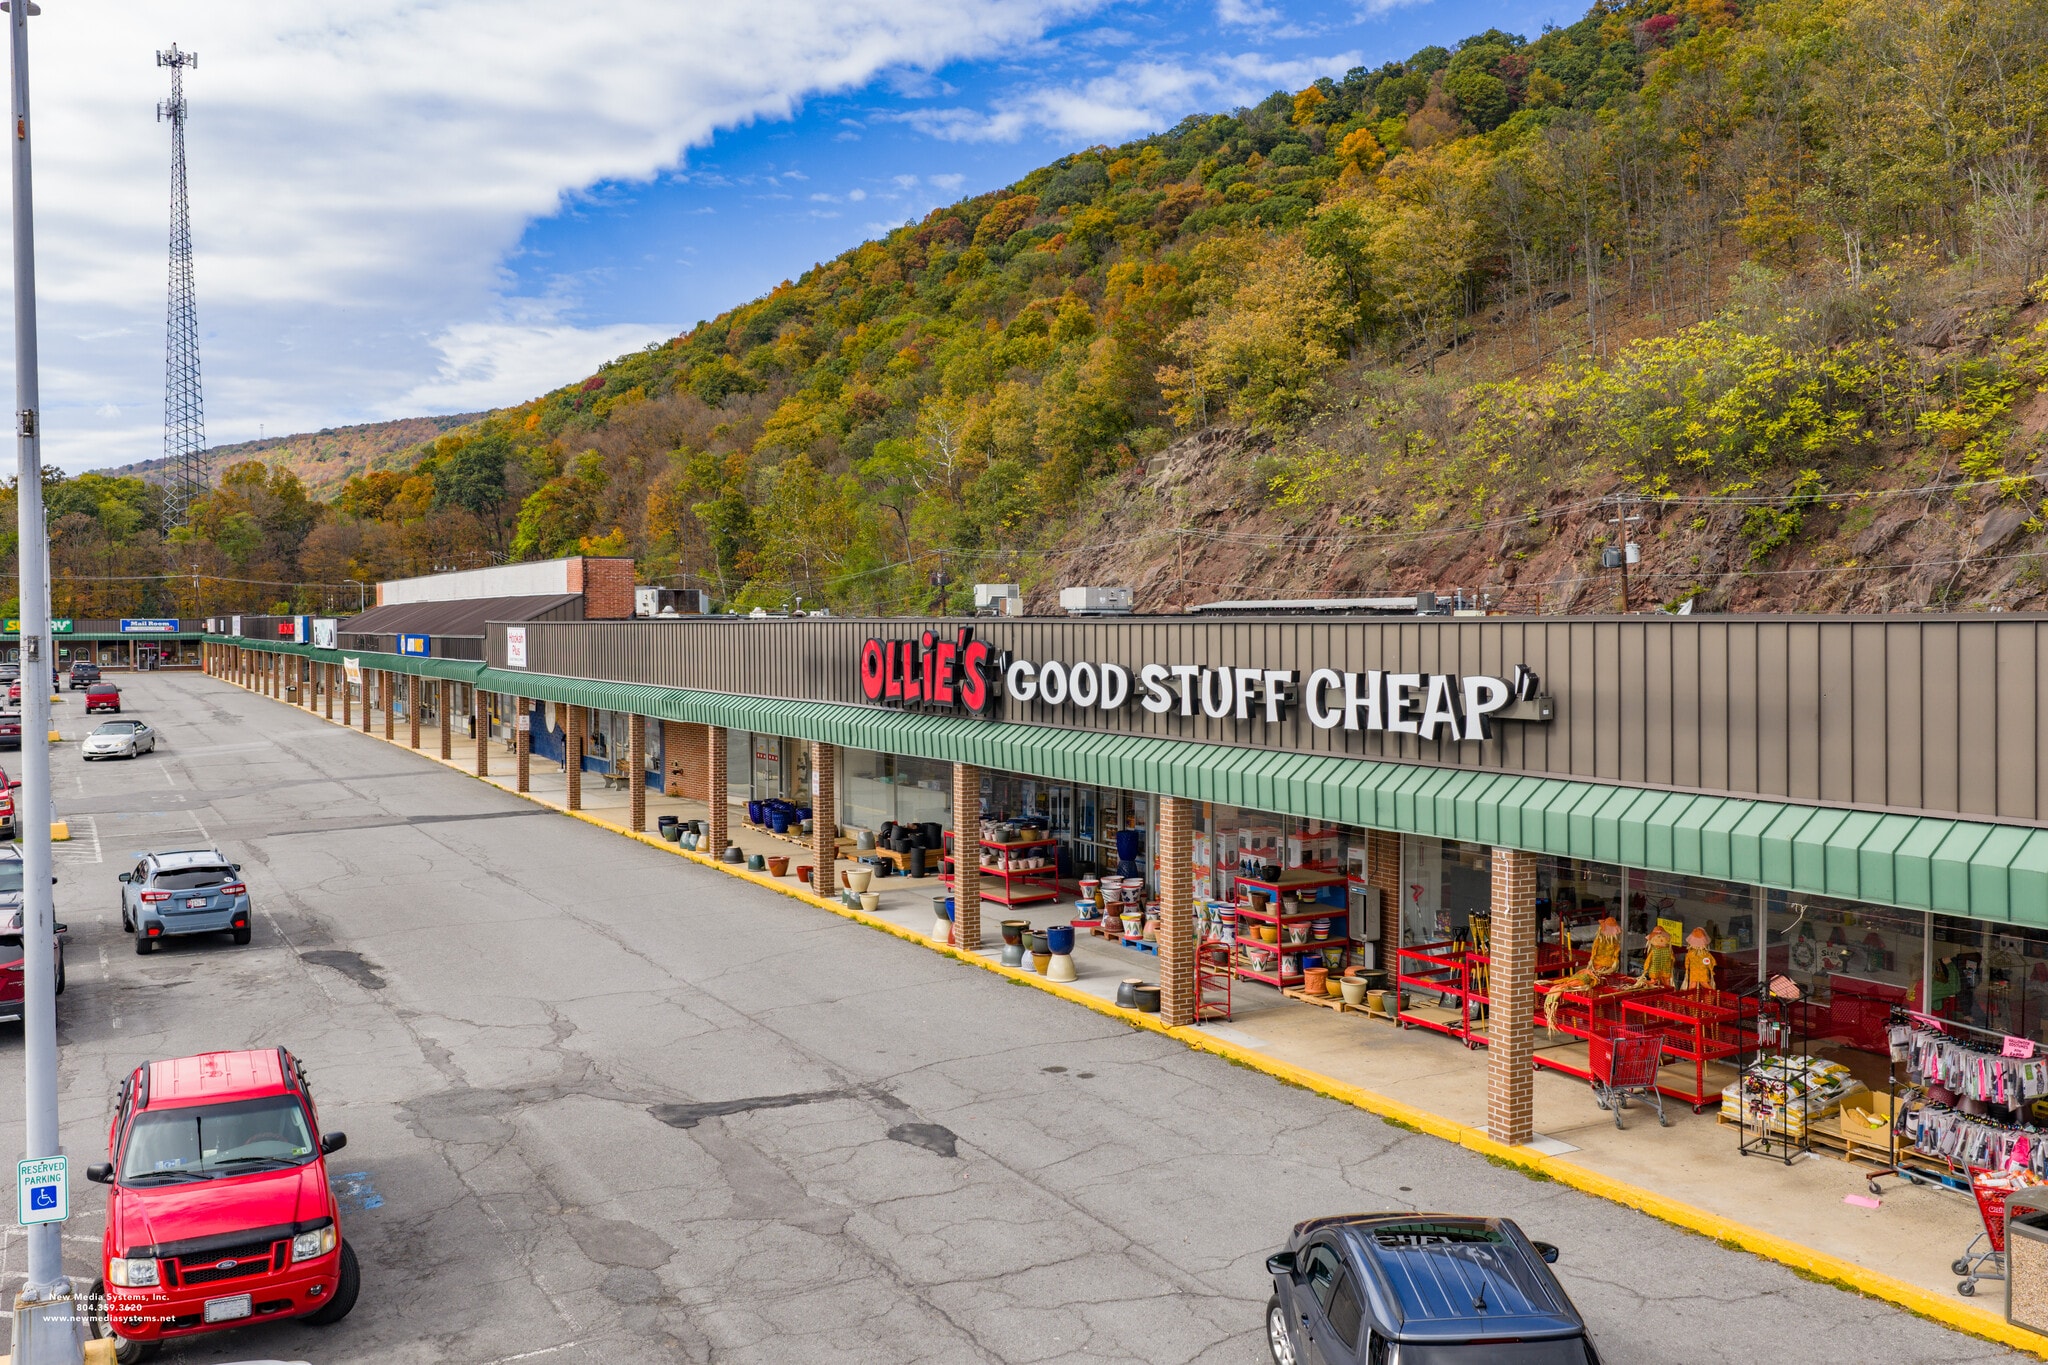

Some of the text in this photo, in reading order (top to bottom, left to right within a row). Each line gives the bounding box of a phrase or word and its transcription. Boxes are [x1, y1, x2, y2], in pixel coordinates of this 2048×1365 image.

[1141, 664, 1298, 722] STUFF
[21, 1162, 64, 1175] RESERVED
[24, 1174, 61, 1185] PARKING
